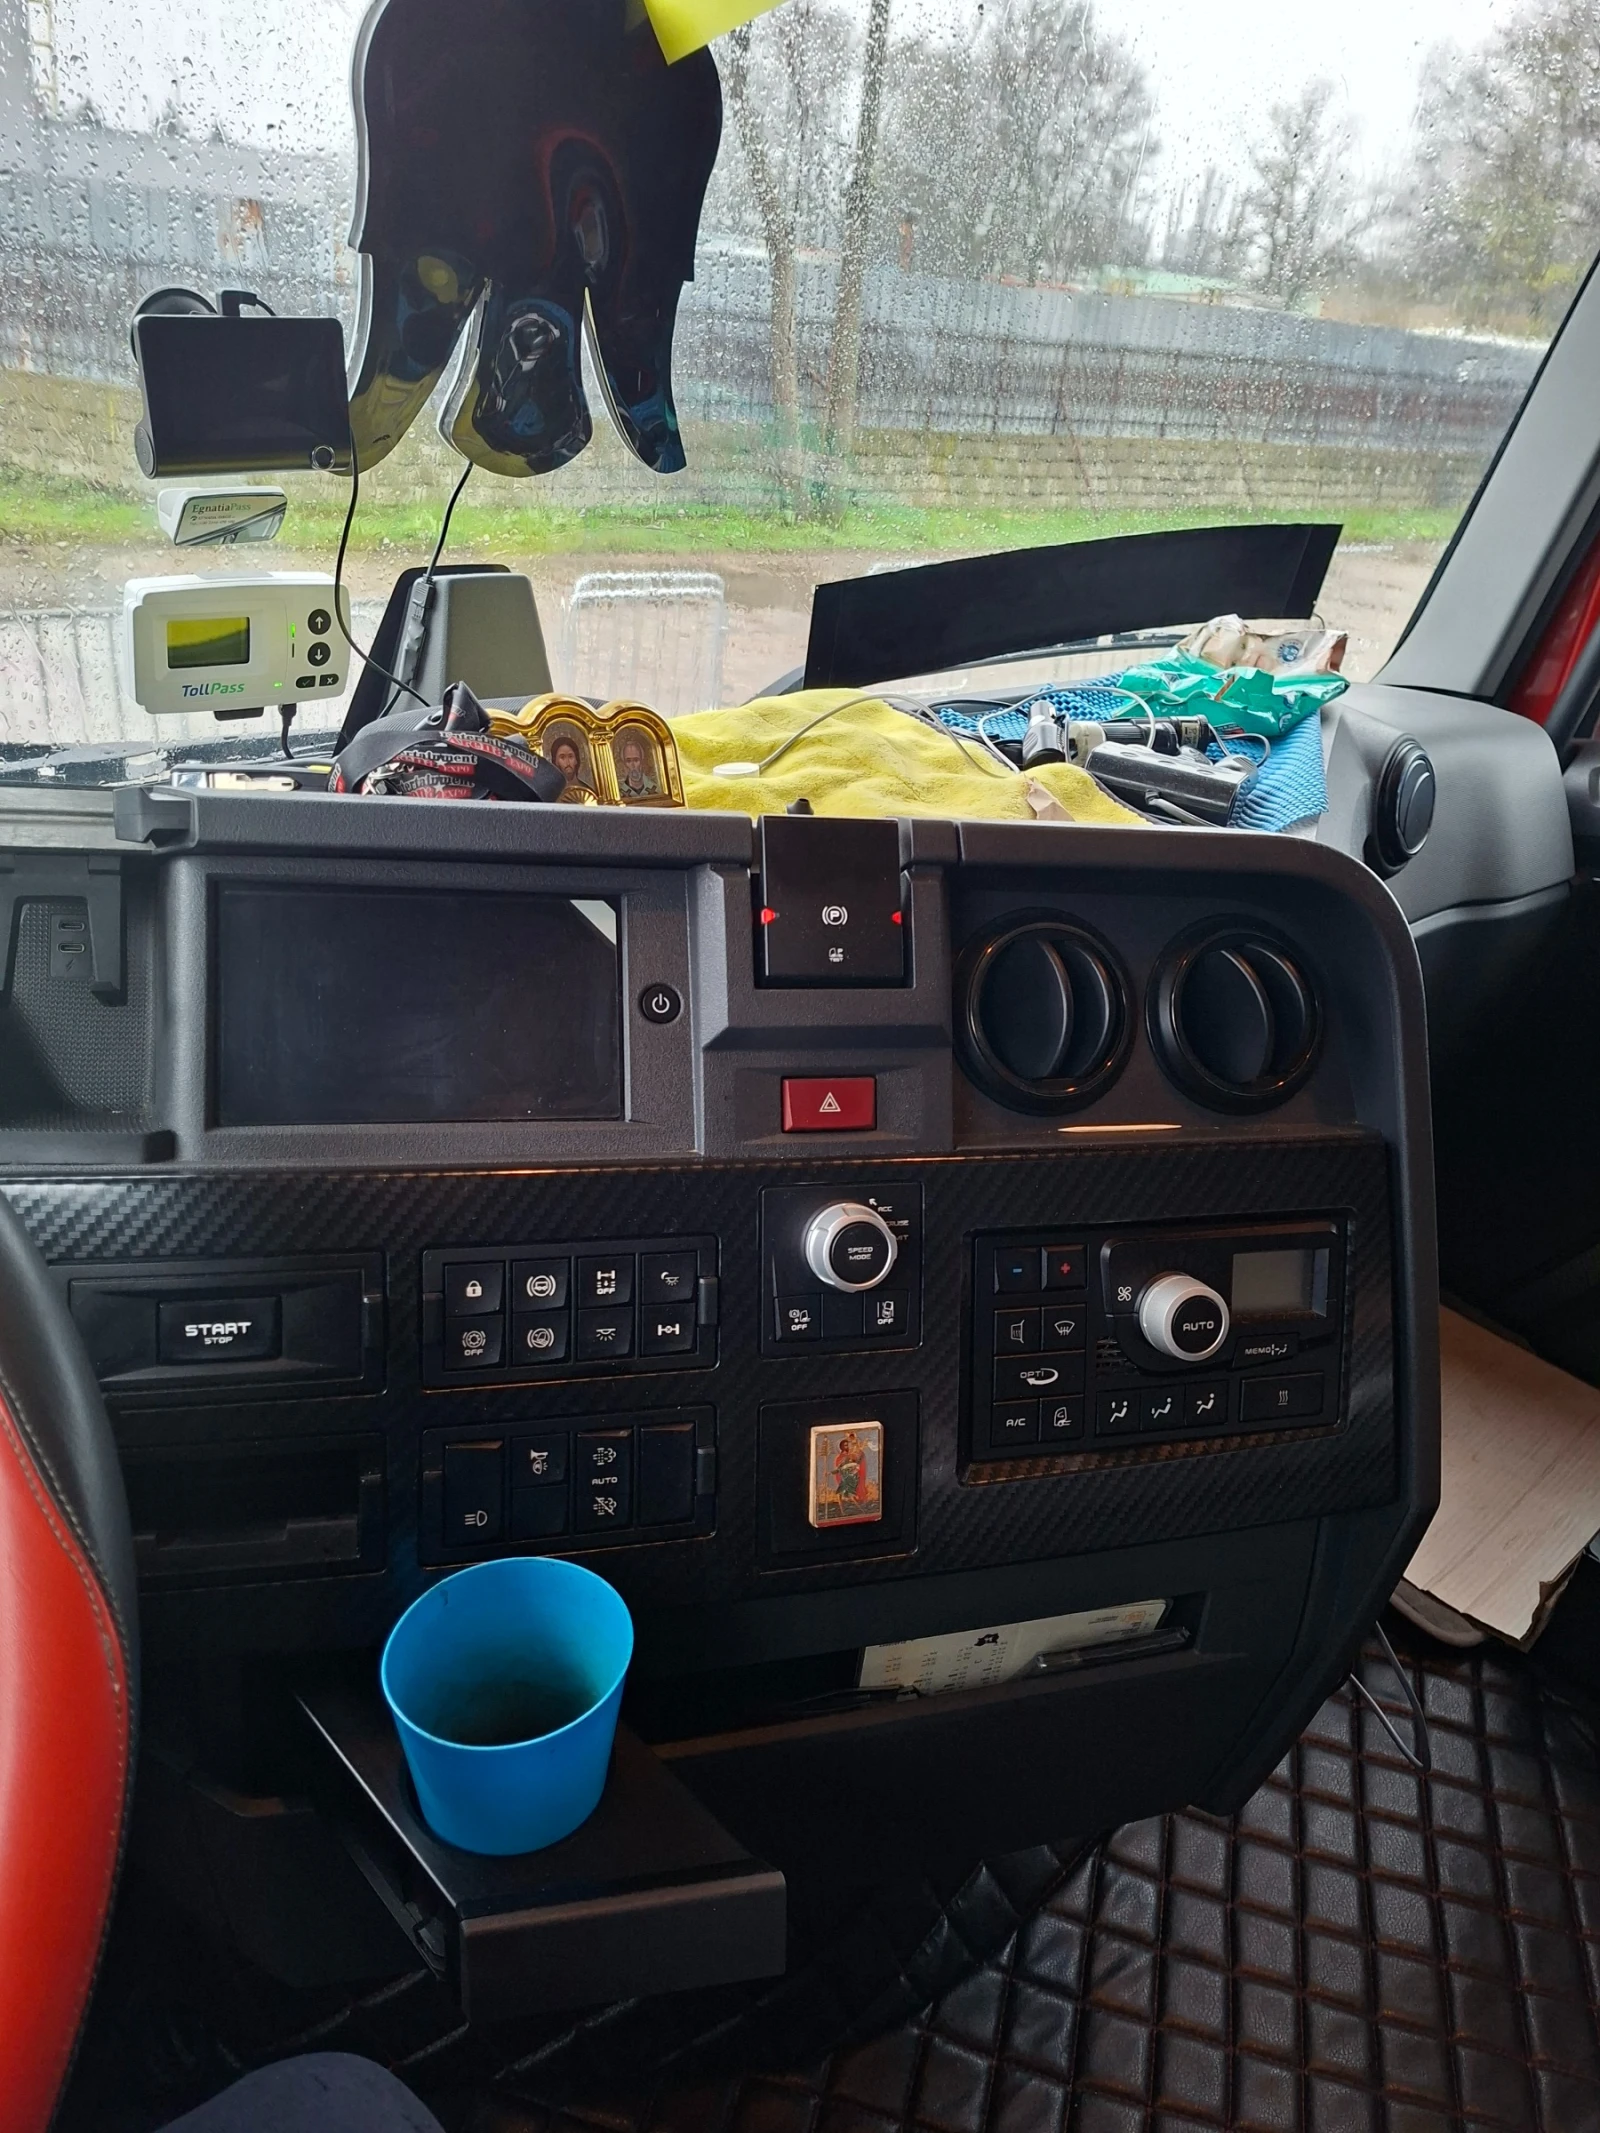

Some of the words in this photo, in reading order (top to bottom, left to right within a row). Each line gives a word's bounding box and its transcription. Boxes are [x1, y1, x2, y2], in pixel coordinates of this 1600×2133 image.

[192, 503, 251, 514] EgnatiaPass
[182, 682, 245, 698] TollPass
[507, 757, 532, 775] EXPO
[847, 1246, 874, 1254] SPEED
[596, 1287, 616, 1296] OFF
[877, 1317, 894, 1325] OFF
[184, 1322, 252, 1338] START
[791, 1323, 808, 1331] OFF
[1183, 1320, 1215, 1332] AUTO
[204, 1336, 233, 1345] STOP
[464, 1349, 484, 1357] OFF
[1244, 1346, 1271, 1355] MEMO
[1020, 1370, 1044, 1379] OPTI
[1006, 1417, 1026, 1427] A/C
[591, 1476, 618, 1485] AUTO
